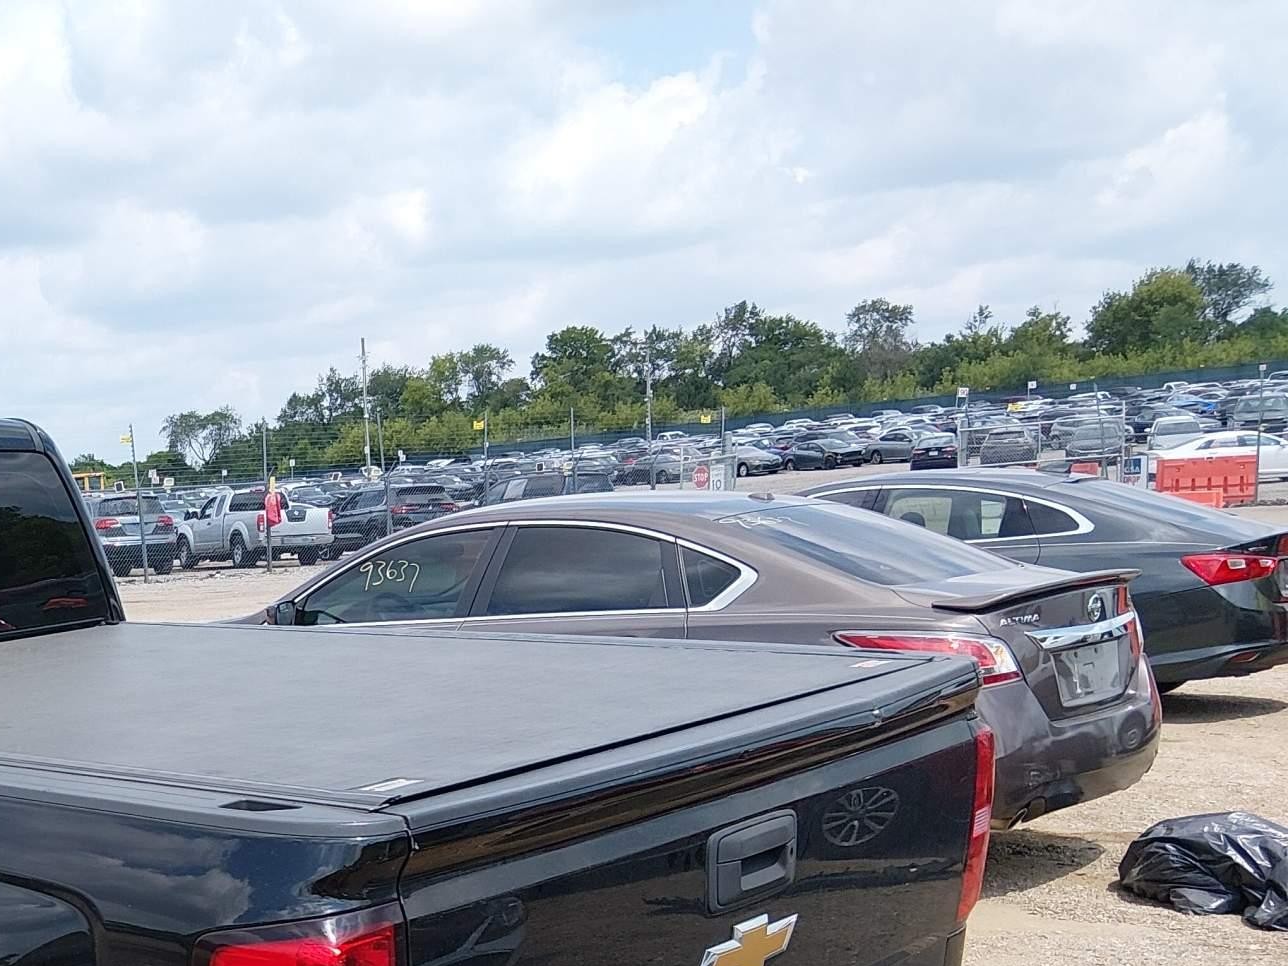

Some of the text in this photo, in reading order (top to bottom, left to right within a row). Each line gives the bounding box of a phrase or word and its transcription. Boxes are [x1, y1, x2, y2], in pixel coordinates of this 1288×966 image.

[693, 472, 709, 482] STOP
[359, 560, 420, 593] 93637
[999, 613, 1040, 627] ALTIMA
